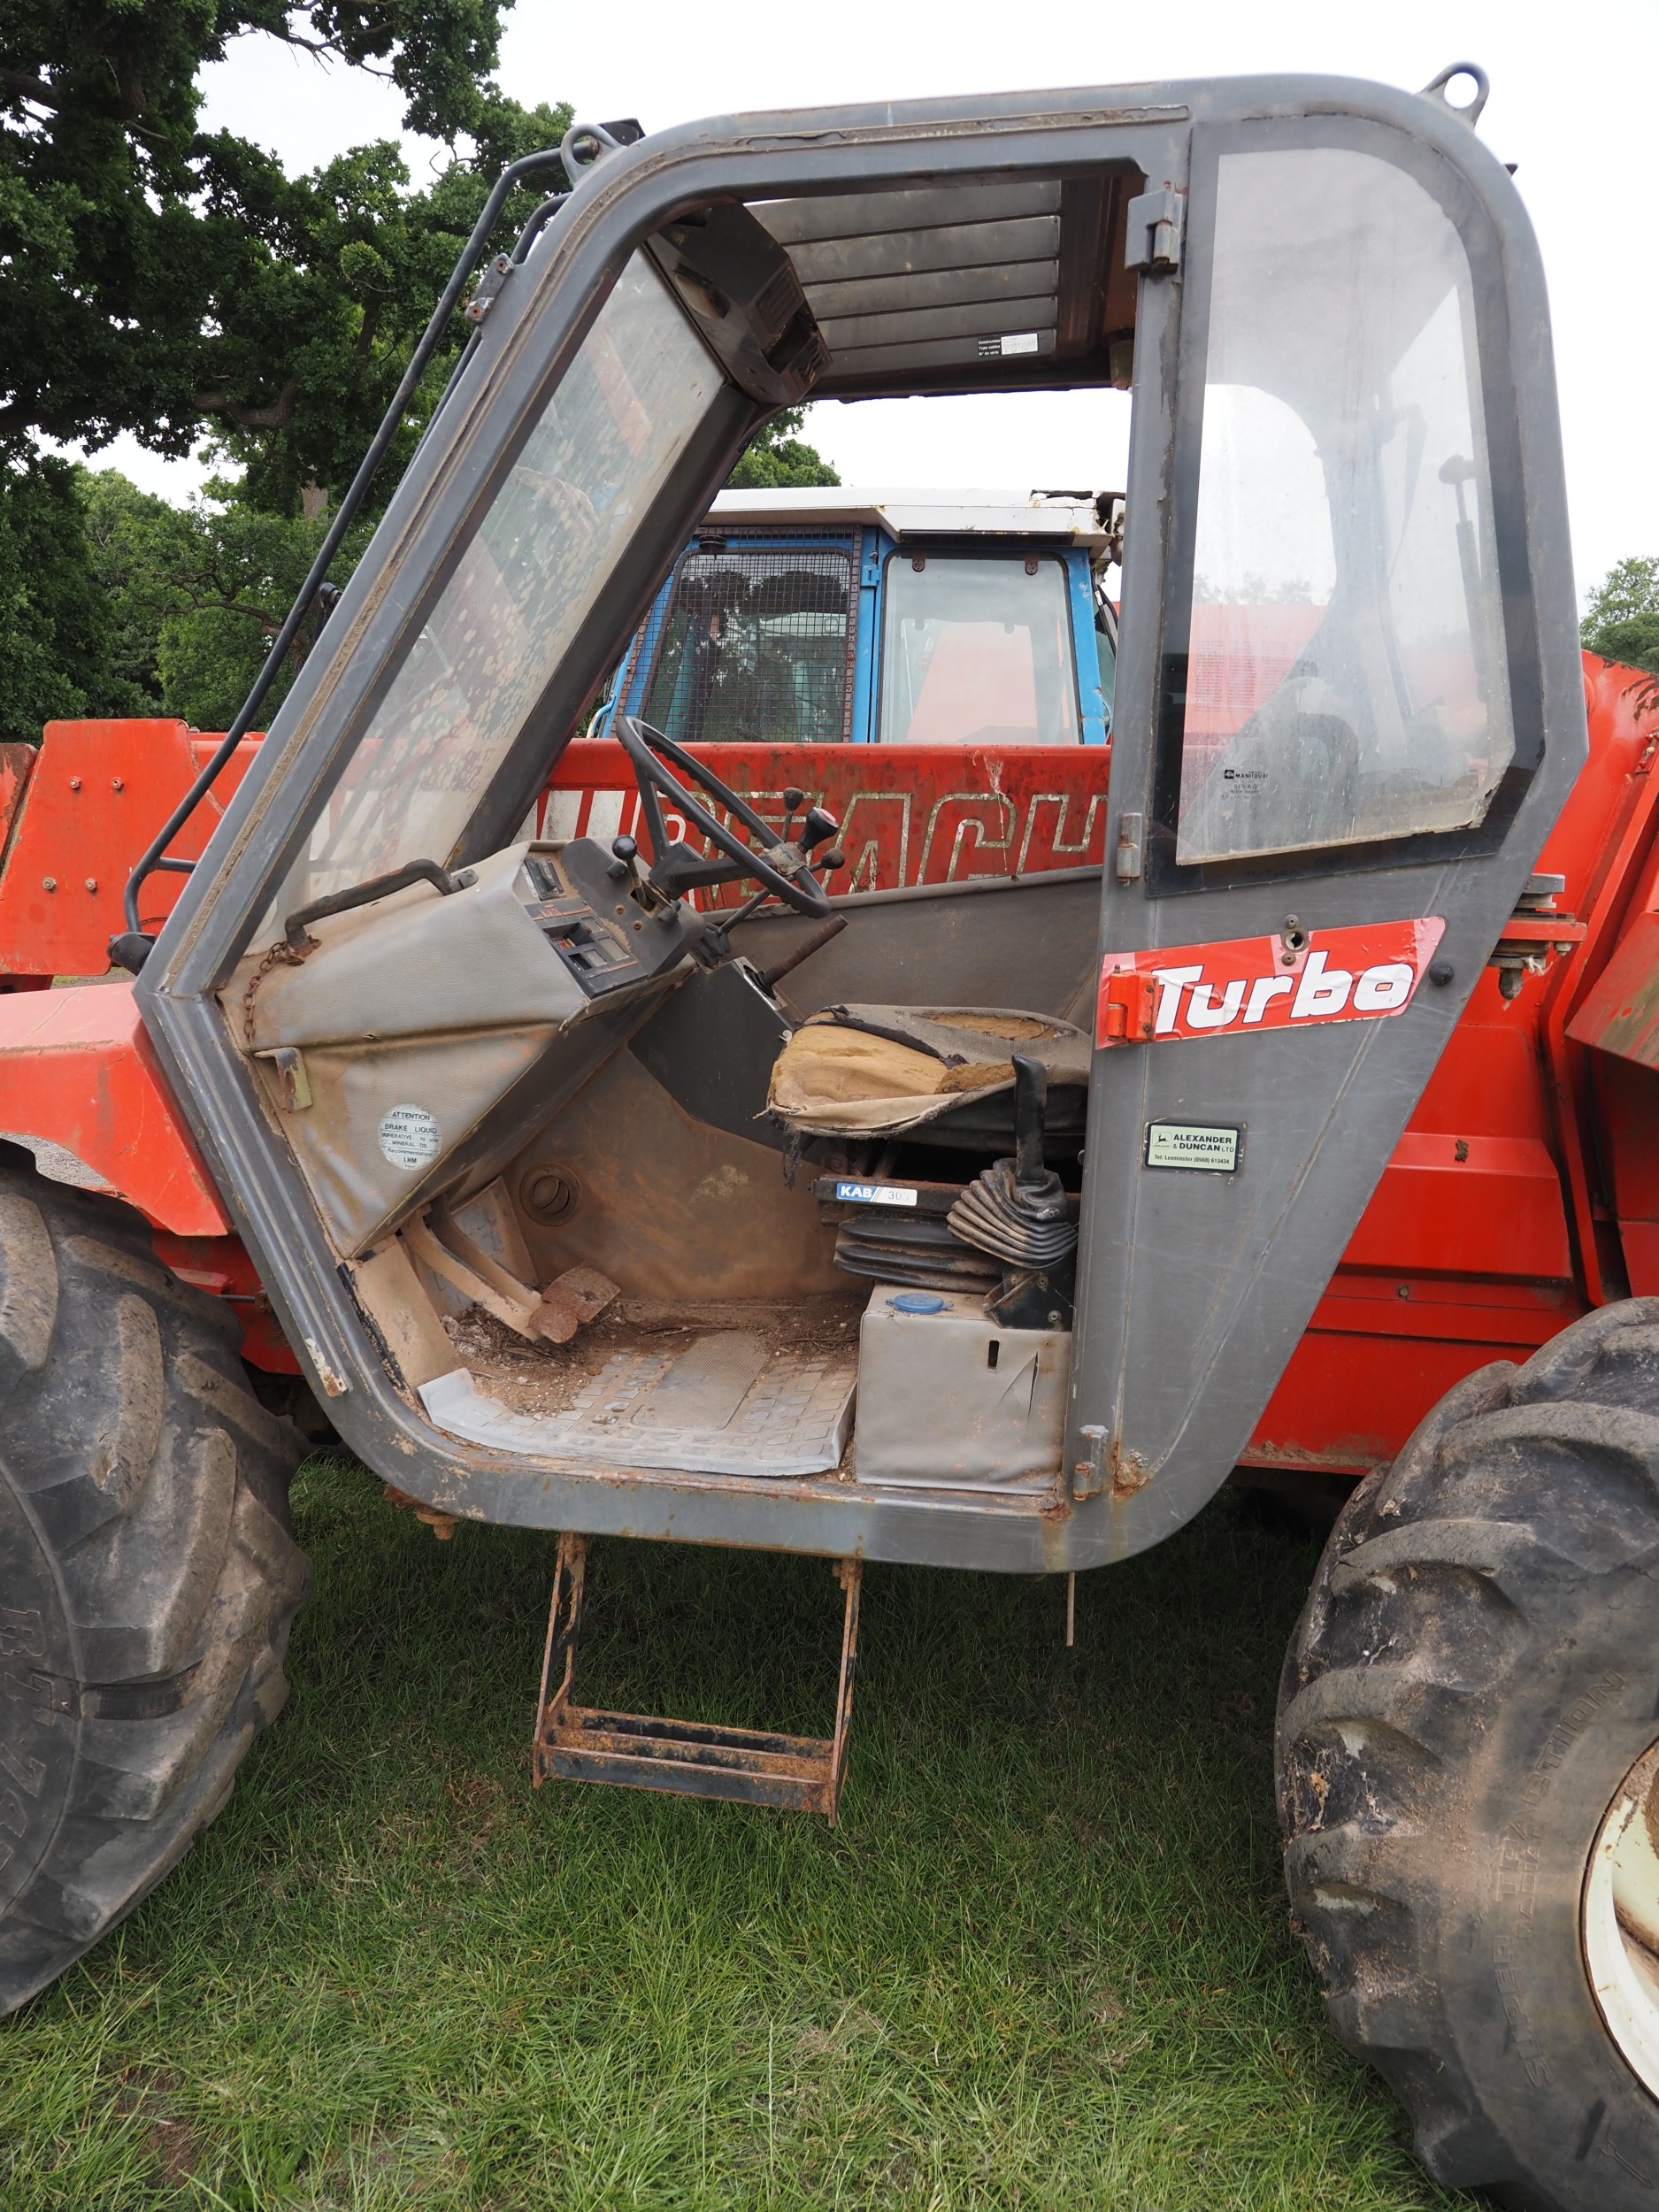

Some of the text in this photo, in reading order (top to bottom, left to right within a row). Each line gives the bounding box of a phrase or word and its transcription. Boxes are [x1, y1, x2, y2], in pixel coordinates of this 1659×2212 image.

[1150, 949, 1415, 1034] Turbo
[392, 1111, 431, 1121] ATTENTION
[384, 1123, 408, 1132] BRAKE
[1173, 1134, 1232, 1144] ALEXANDER
[1179, 1142, 1220, 1152] DUNCAN
[841, 1186, 872, 1198] KAB
[1493, 1668, 1627, 2089] SUPER TRACTION
[1517, 1818, 1550, 1939] RADIAL
